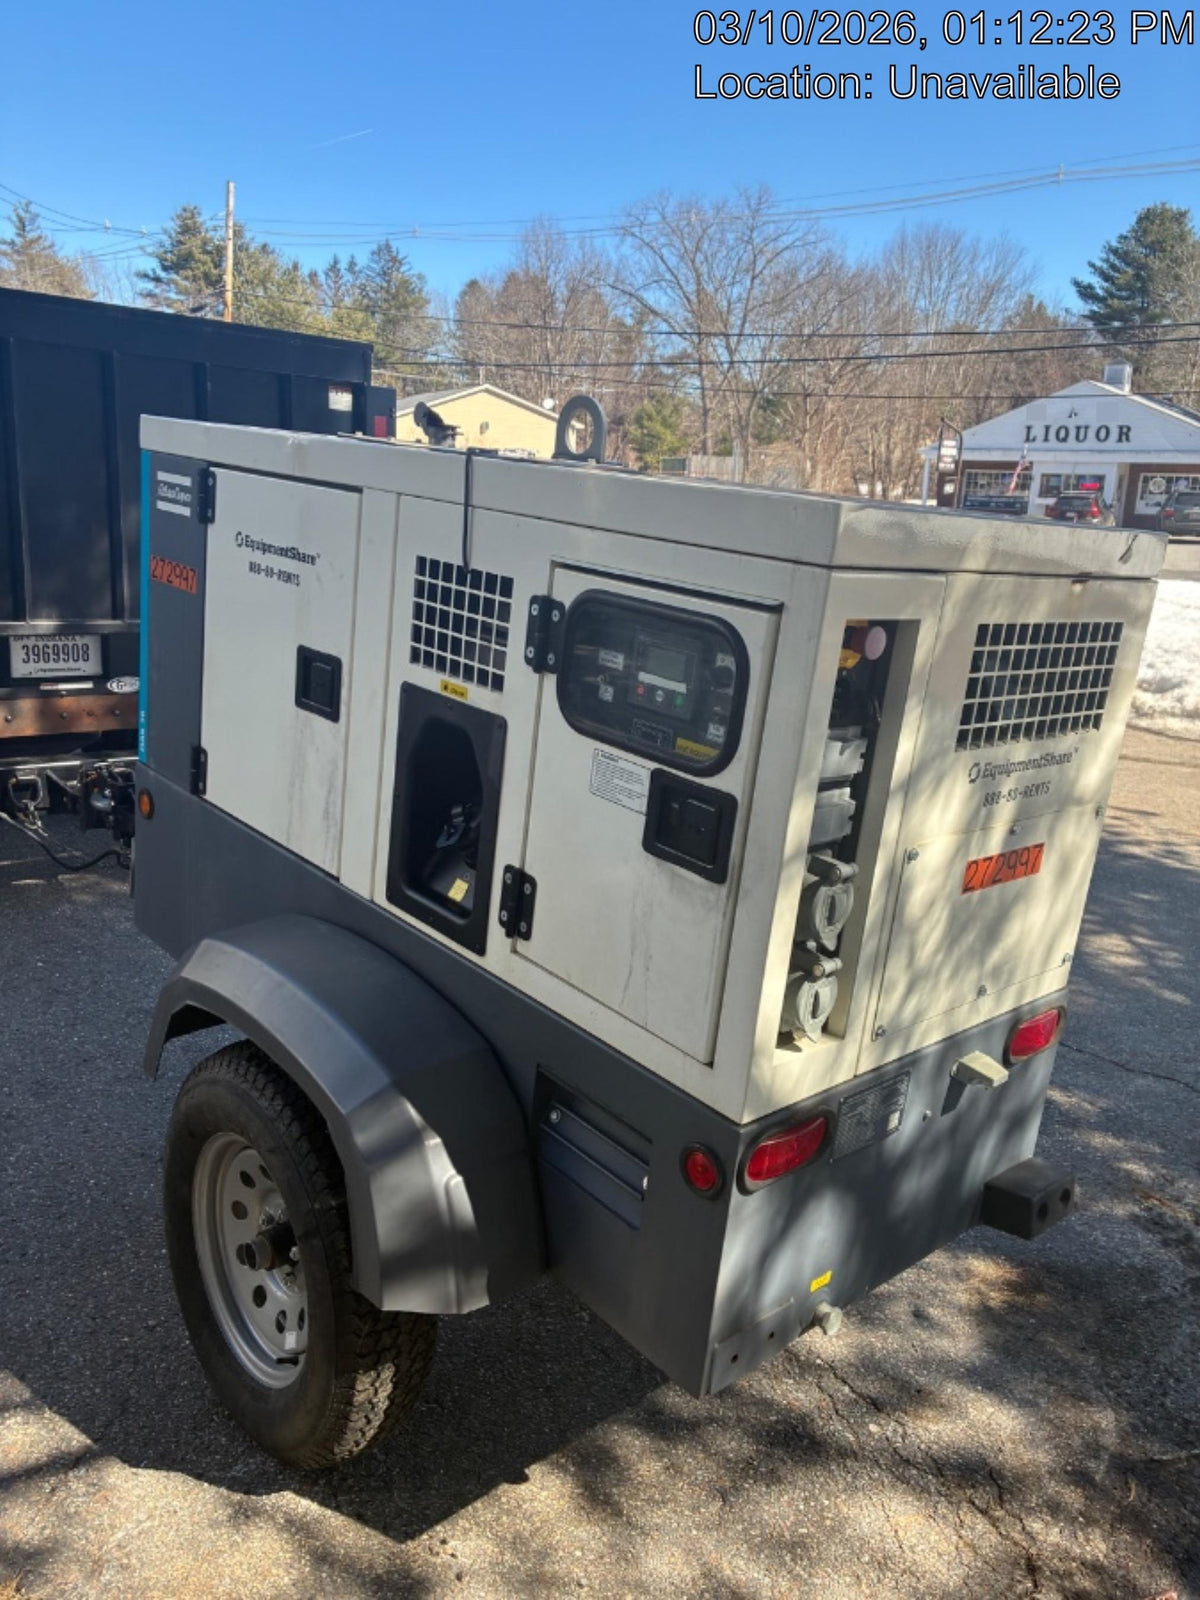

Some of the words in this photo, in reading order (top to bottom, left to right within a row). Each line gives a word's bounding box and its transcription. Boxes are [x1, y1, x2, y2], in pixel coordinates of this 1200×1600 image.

[1025, 424, 1133, 444] LIQUOR
[244, 534, 317, 566] EquipmentShare
[151, 556, 197, 592] 272997
[22, 643, 90, 664] 3969908
[963, 843, 1044, 893] 272997
